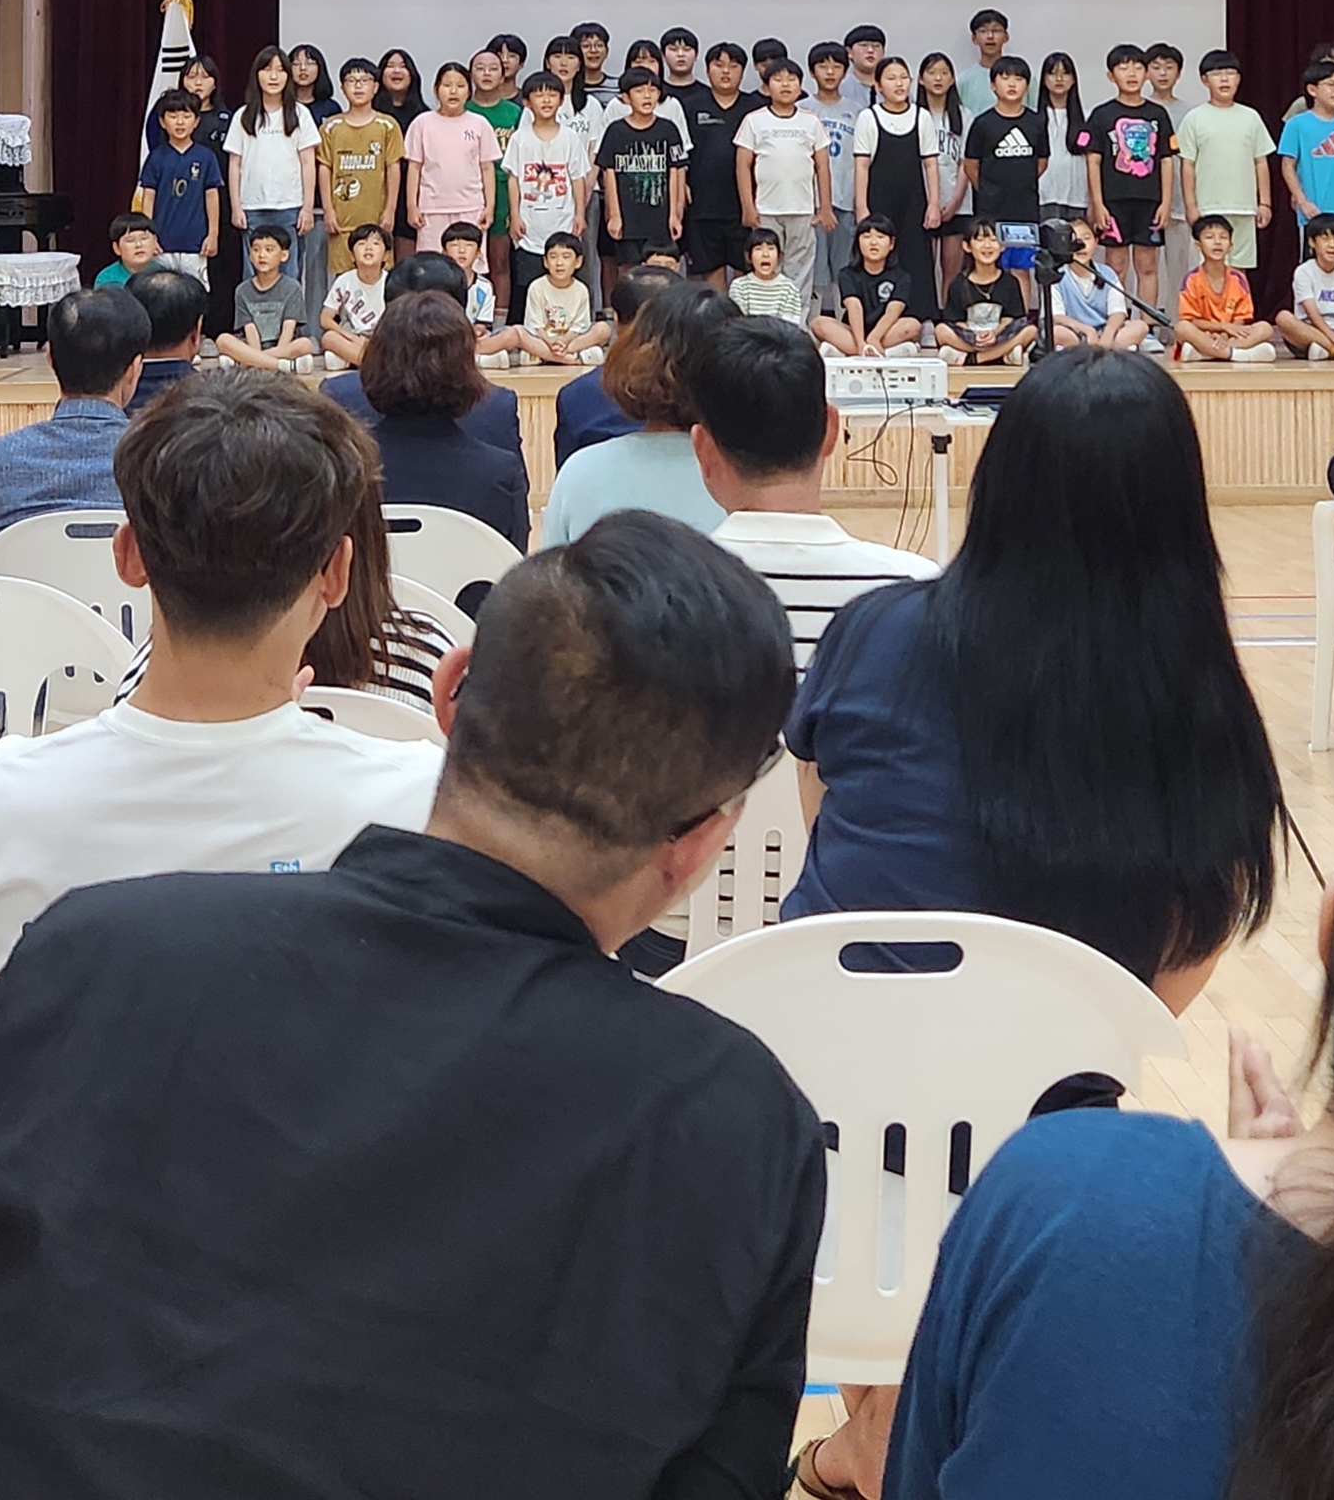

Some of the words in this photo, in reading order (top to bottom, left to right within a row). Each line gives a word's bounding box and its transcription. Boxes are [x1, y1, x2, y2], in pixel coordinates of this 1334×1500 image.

[994, 145, 1034, 158] adidas
[339, 154, 376, 172] NINJA
[614, 153, 668, 173] PLAYER
[171, 177, 188, 198] 10
